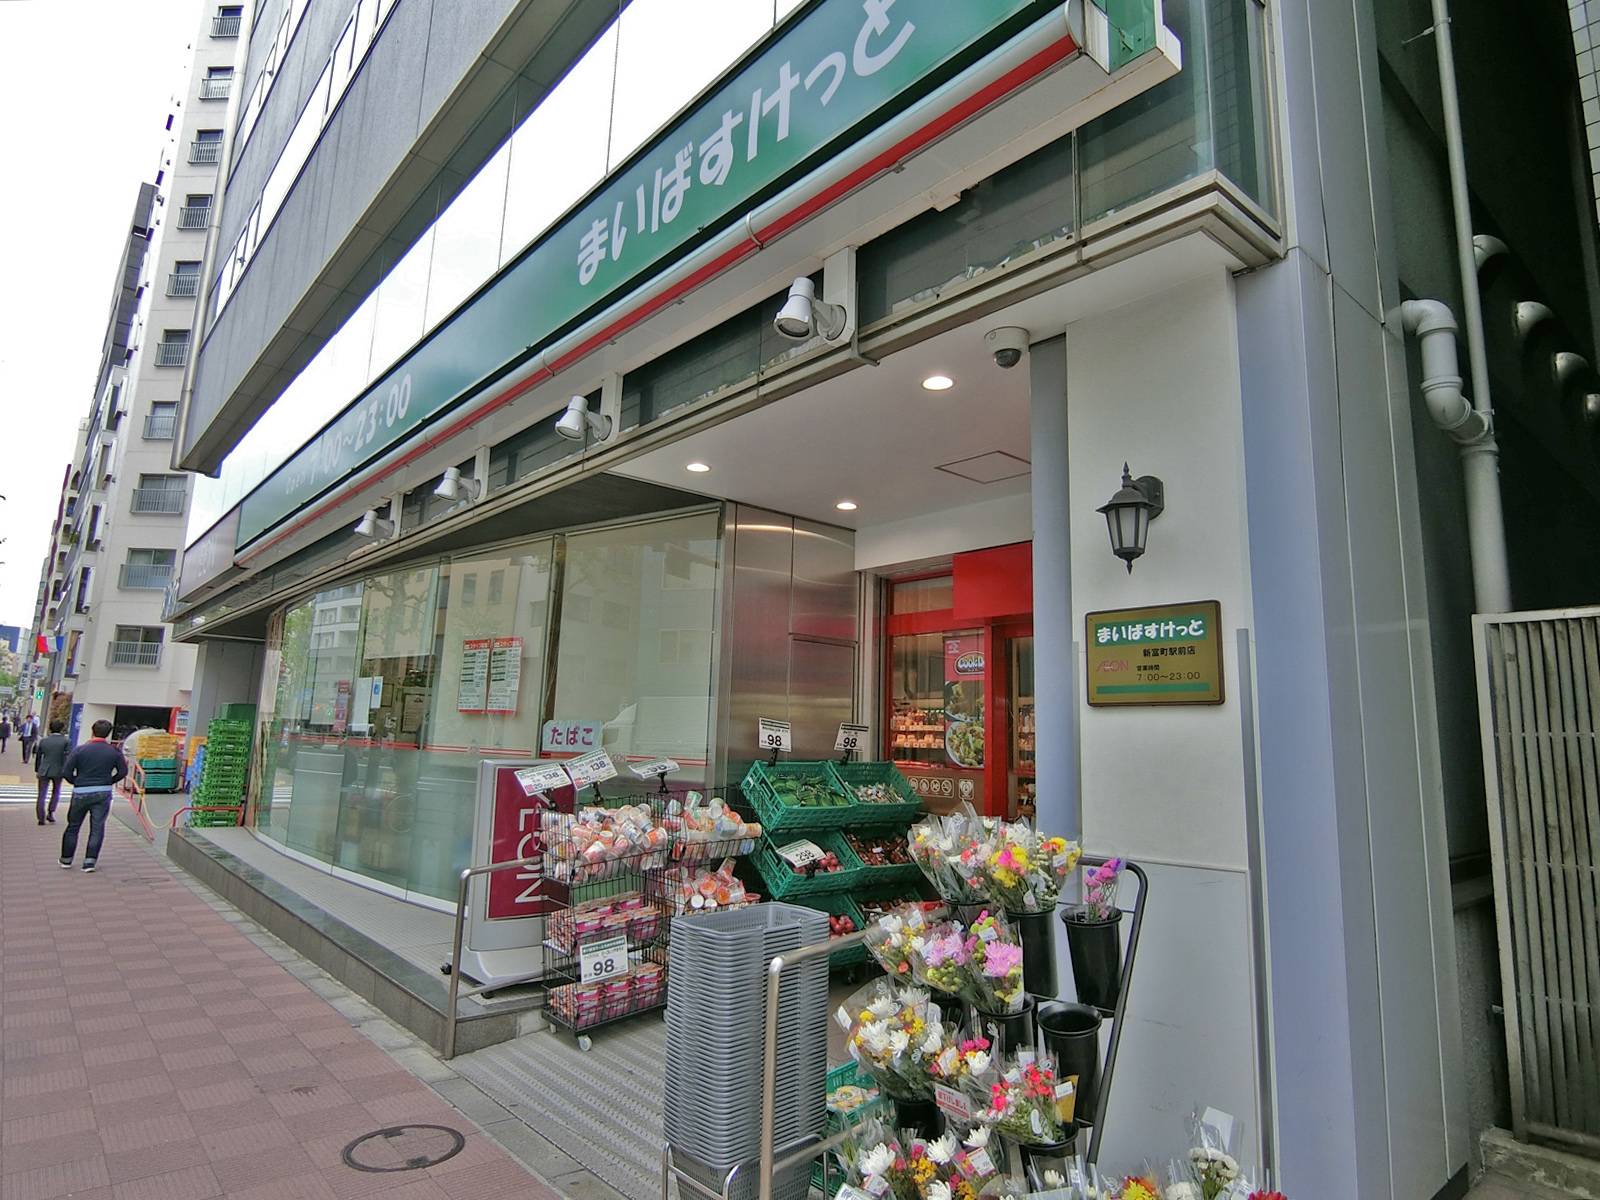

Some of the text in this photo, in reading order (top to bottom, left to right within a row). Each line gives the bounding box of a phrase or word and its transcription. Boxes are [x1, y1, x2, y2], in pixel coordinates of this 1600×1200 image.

[578, 0, 915, 286] まいばすけっと
[1097, 619, 1204, 643] まいばすけっと
[1142, 645, 1196, 658] 新富町駅前店
[551, 727, 593, 746] たばこ
[767, 734, 782, 747] 98
[842, 737, 857, 748] 98
[589, 760, 606, 772] 138
[542, 771, 560, 781] 138
[532, 782, 544, 790] 20
[795, 849, 815, 862] 298
[593, 958, 615, 976] 98
